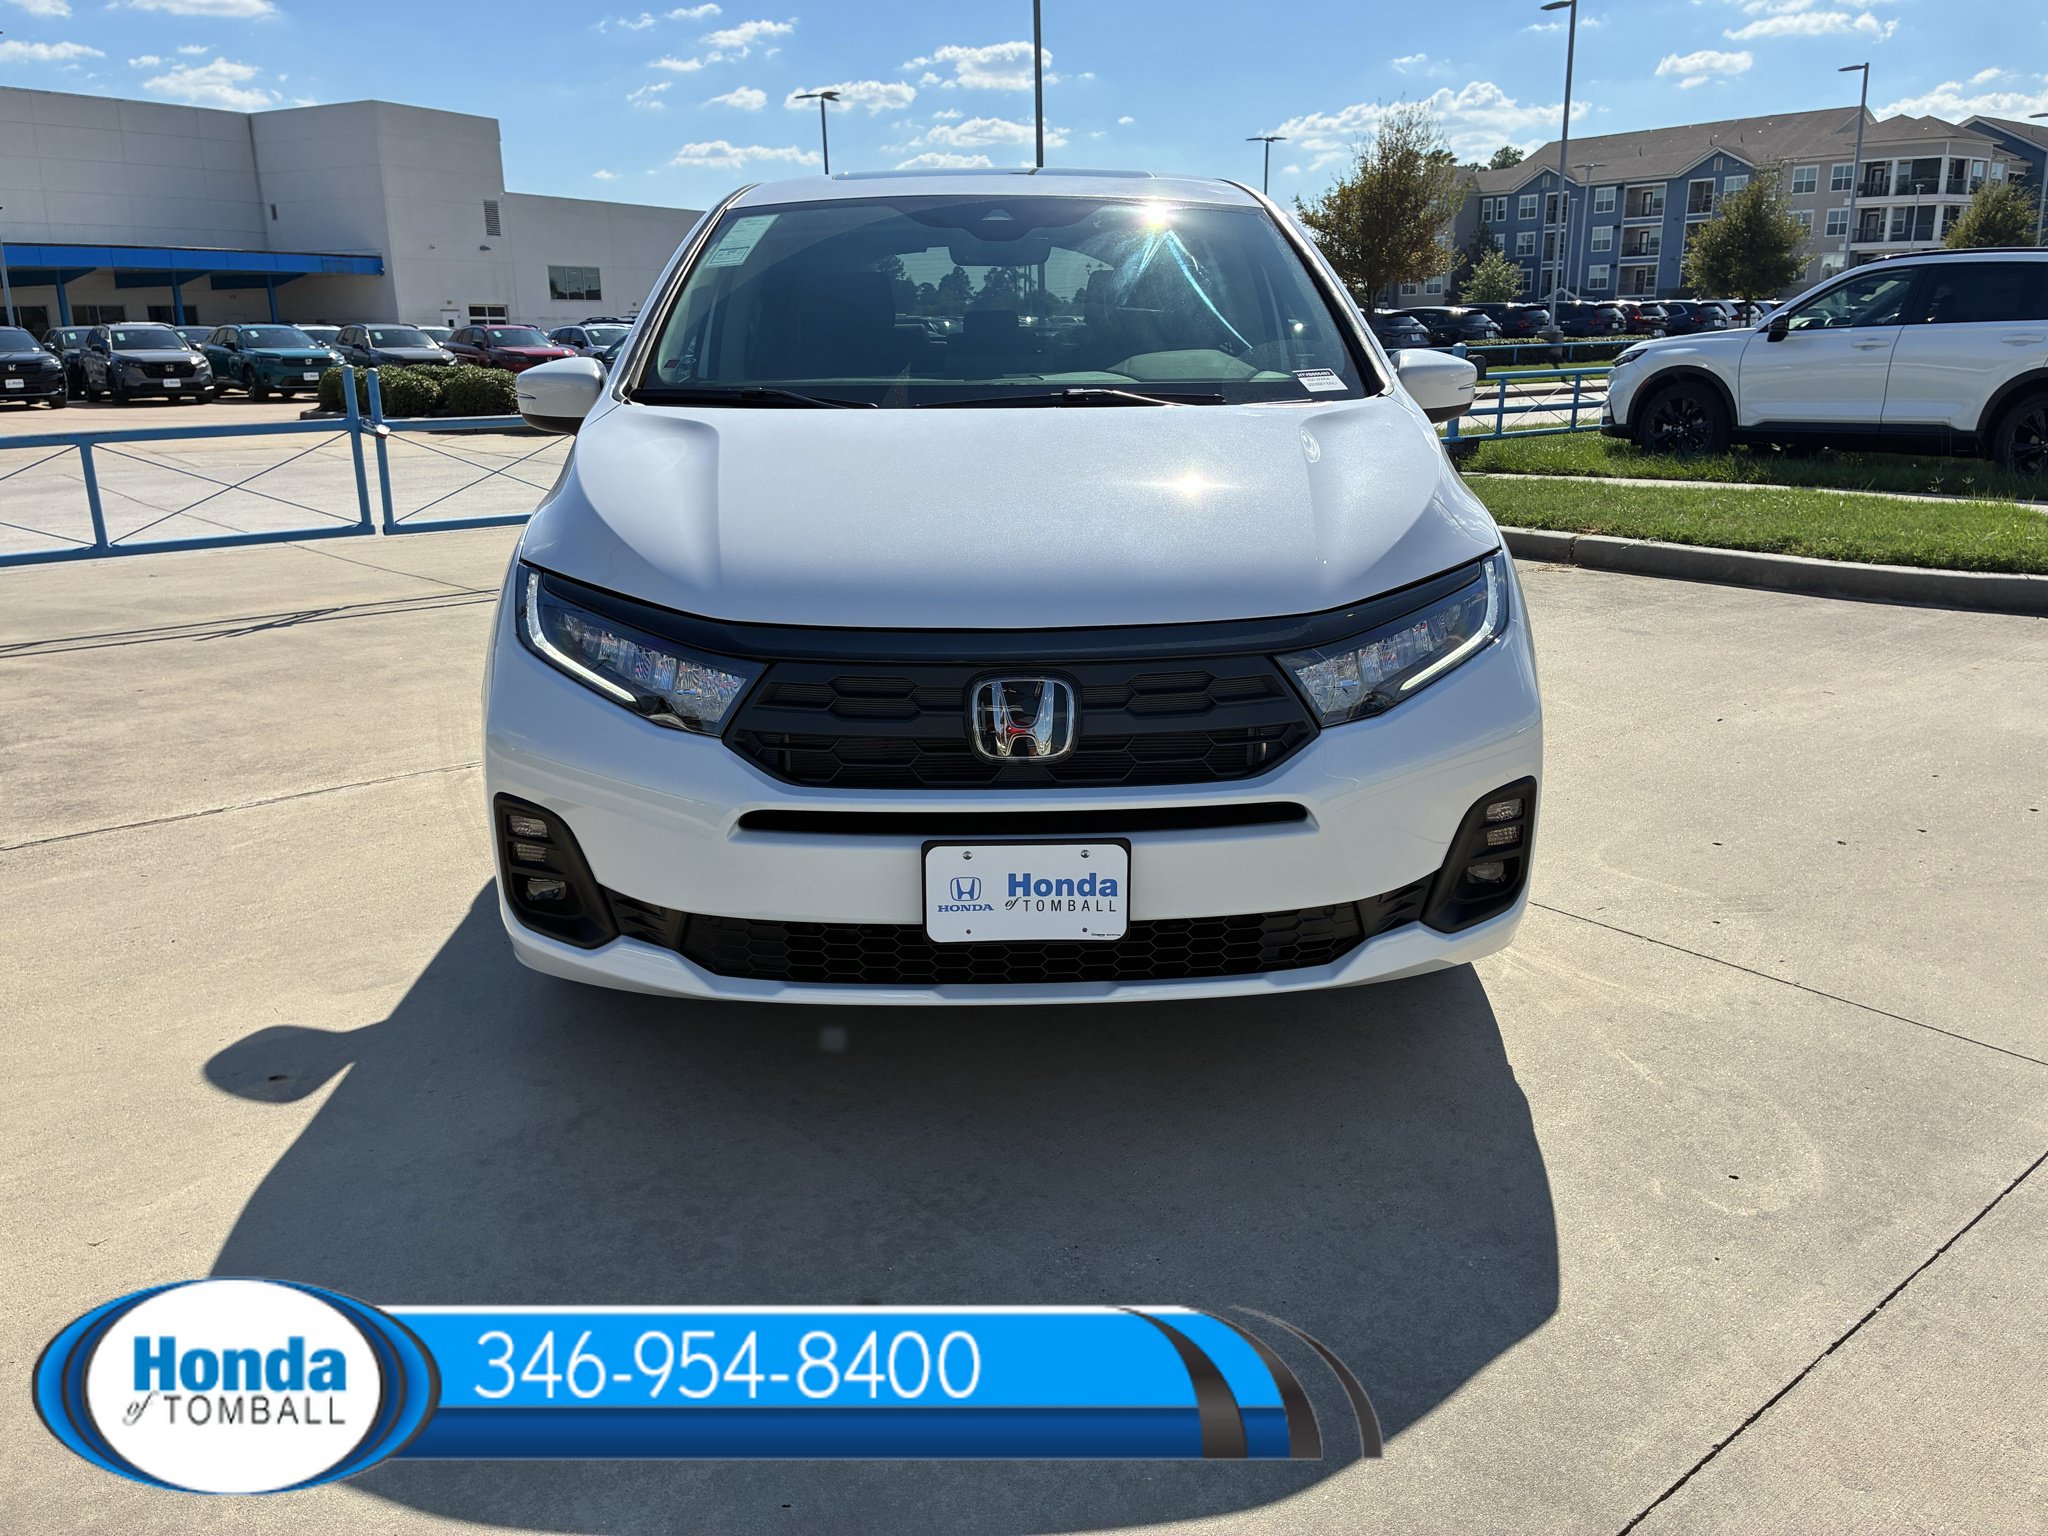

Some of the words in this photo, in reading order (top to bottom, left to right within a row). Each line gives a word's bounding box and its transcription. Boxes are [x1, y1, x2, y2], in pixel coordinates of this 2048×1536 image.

[1007, 873, 1118, 897] Honda
[937, 904, 994, 913] HONDA
[1004, 897, 1021, 911] of
[1024, 899, 1117, 912] TOMBALL
